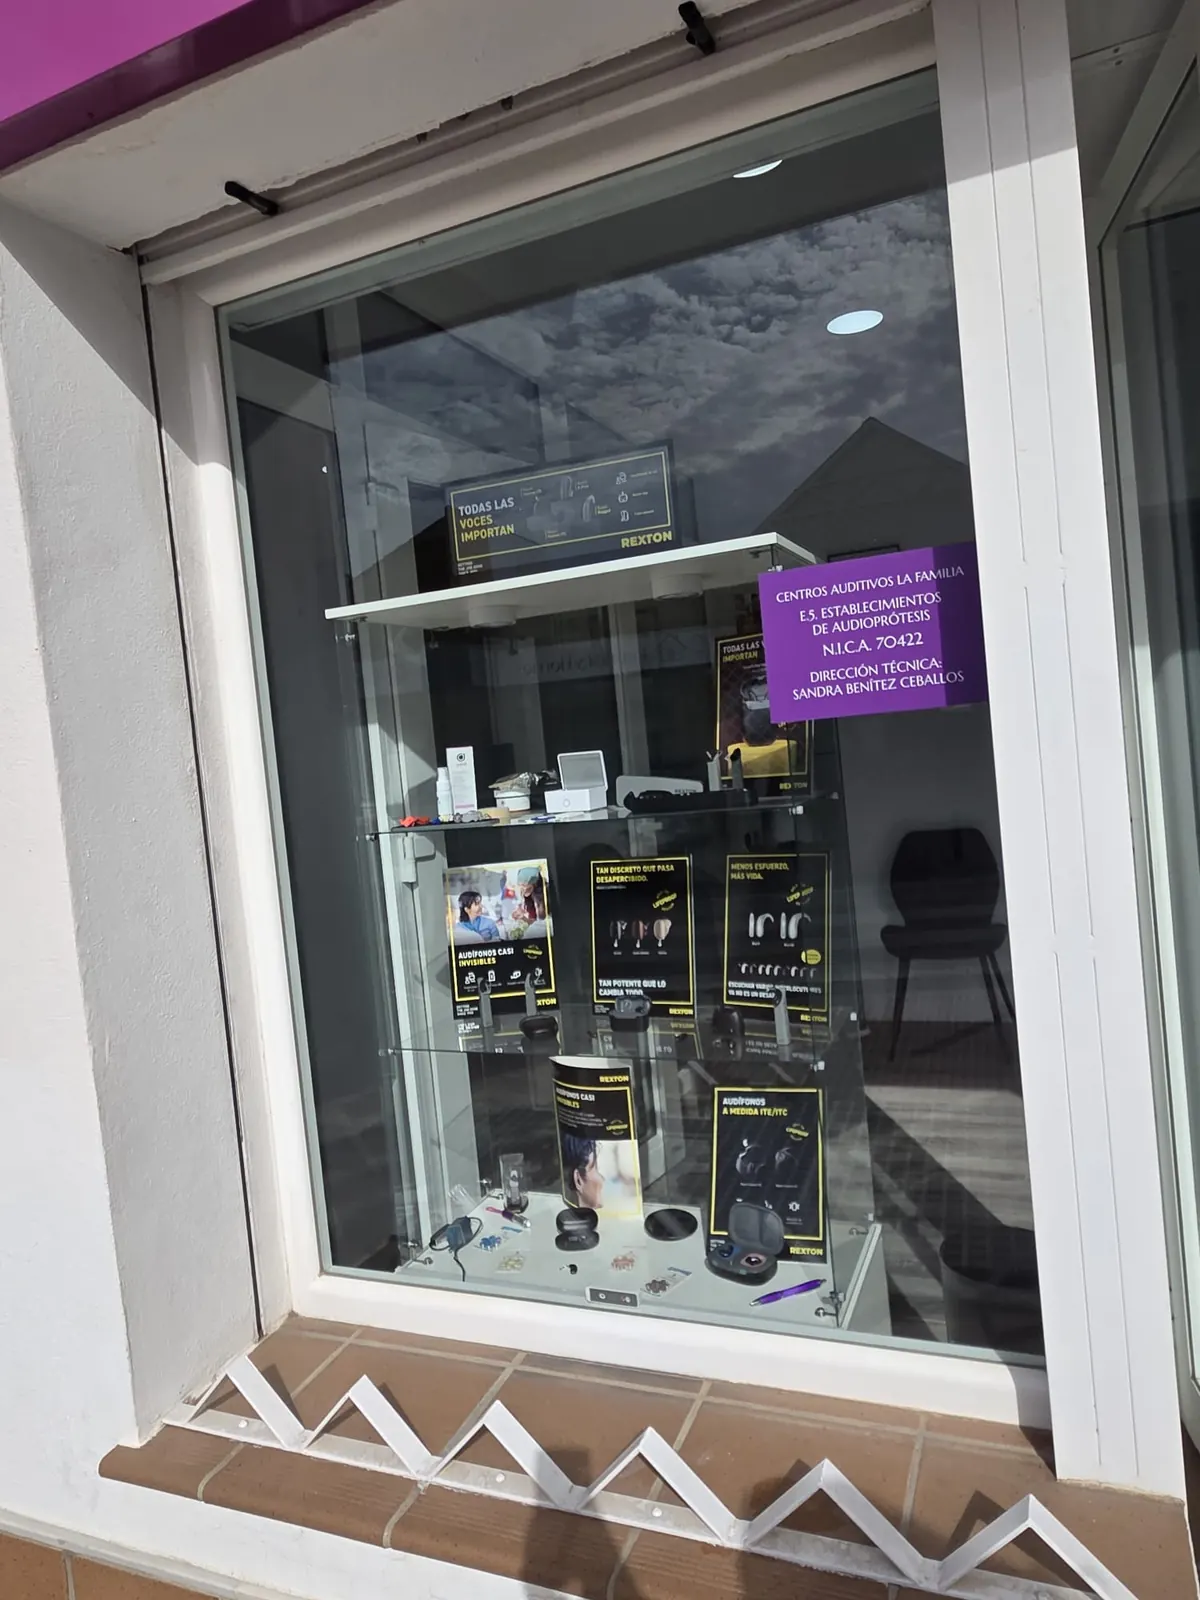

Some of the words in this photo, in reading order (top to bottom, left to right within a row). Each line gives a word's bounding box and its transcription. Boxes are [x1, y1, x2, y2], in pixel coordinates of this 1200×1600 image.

[458, 501, 492, 516] TODAS
[494, 497, 515, 510] LAS
[459, 515, 493, 529] VOCES
[461, 524, 515, 542] IMPORTAN
[621, 531, 672, 548] REXTON
[776, 586, 827, 603] CENTROS
[831, 577, 894, 595] AUDITIVOS
[896, 573, 913, 586] LA
[914, 566, 964, 582] FAMILIA
[821, 592, 942, 619] ESTABLECIMIENTOS
[812, 623, 829, 636] DE
[831, 609, 931, 634] AUDIOPRÓTESIS
[723, 642, 745, 653] TODAS
[746, 640, 760, 650] LAS
[822, 639, 872, 656] N.I.C.A.
[876, 632, 924, 650] 70422
[722, 651, 758, 662] IMPORTAN
[810, 664, 879, 683] DIRECCIÓN
[882, 657, 943, 674] TÉCNICA:
[793, 685, 843, 700] SANDRA
[846, 677, 897, 695] BENÍTEZ
[900, 670, 965, 688] CEBALLOS
[596, 866, 609, 875] TAN
[610, 866, 641, 874] DISCRETO
[643, 865, 656, 873] QUE
[657, 864, 675, 872] PASA
[731, 863, 753, 871] MENOS
[731, 871, 745, 880] MÁS
[458, 947, 497, 960] AUDÍFONOS
[498, 947, 514, 956] CASI
[458, 954, 497, 967] INVISIBLES
[599, 979, 612, 988] TAN
[613, 979, 641, 988] POTENTE
[642, 980, 656, 988] QUE
[657, 980, 666, 989] LO
[600, 1075, 629, 1083] REXTON
[580, 1093, 595, 1102] CASI
[722, 1096, 766, 1106] AUDÍFONOS
[729, 1108, 759, 1116] MEDIDA
[789, 1246, 823, 1256] REXTON
